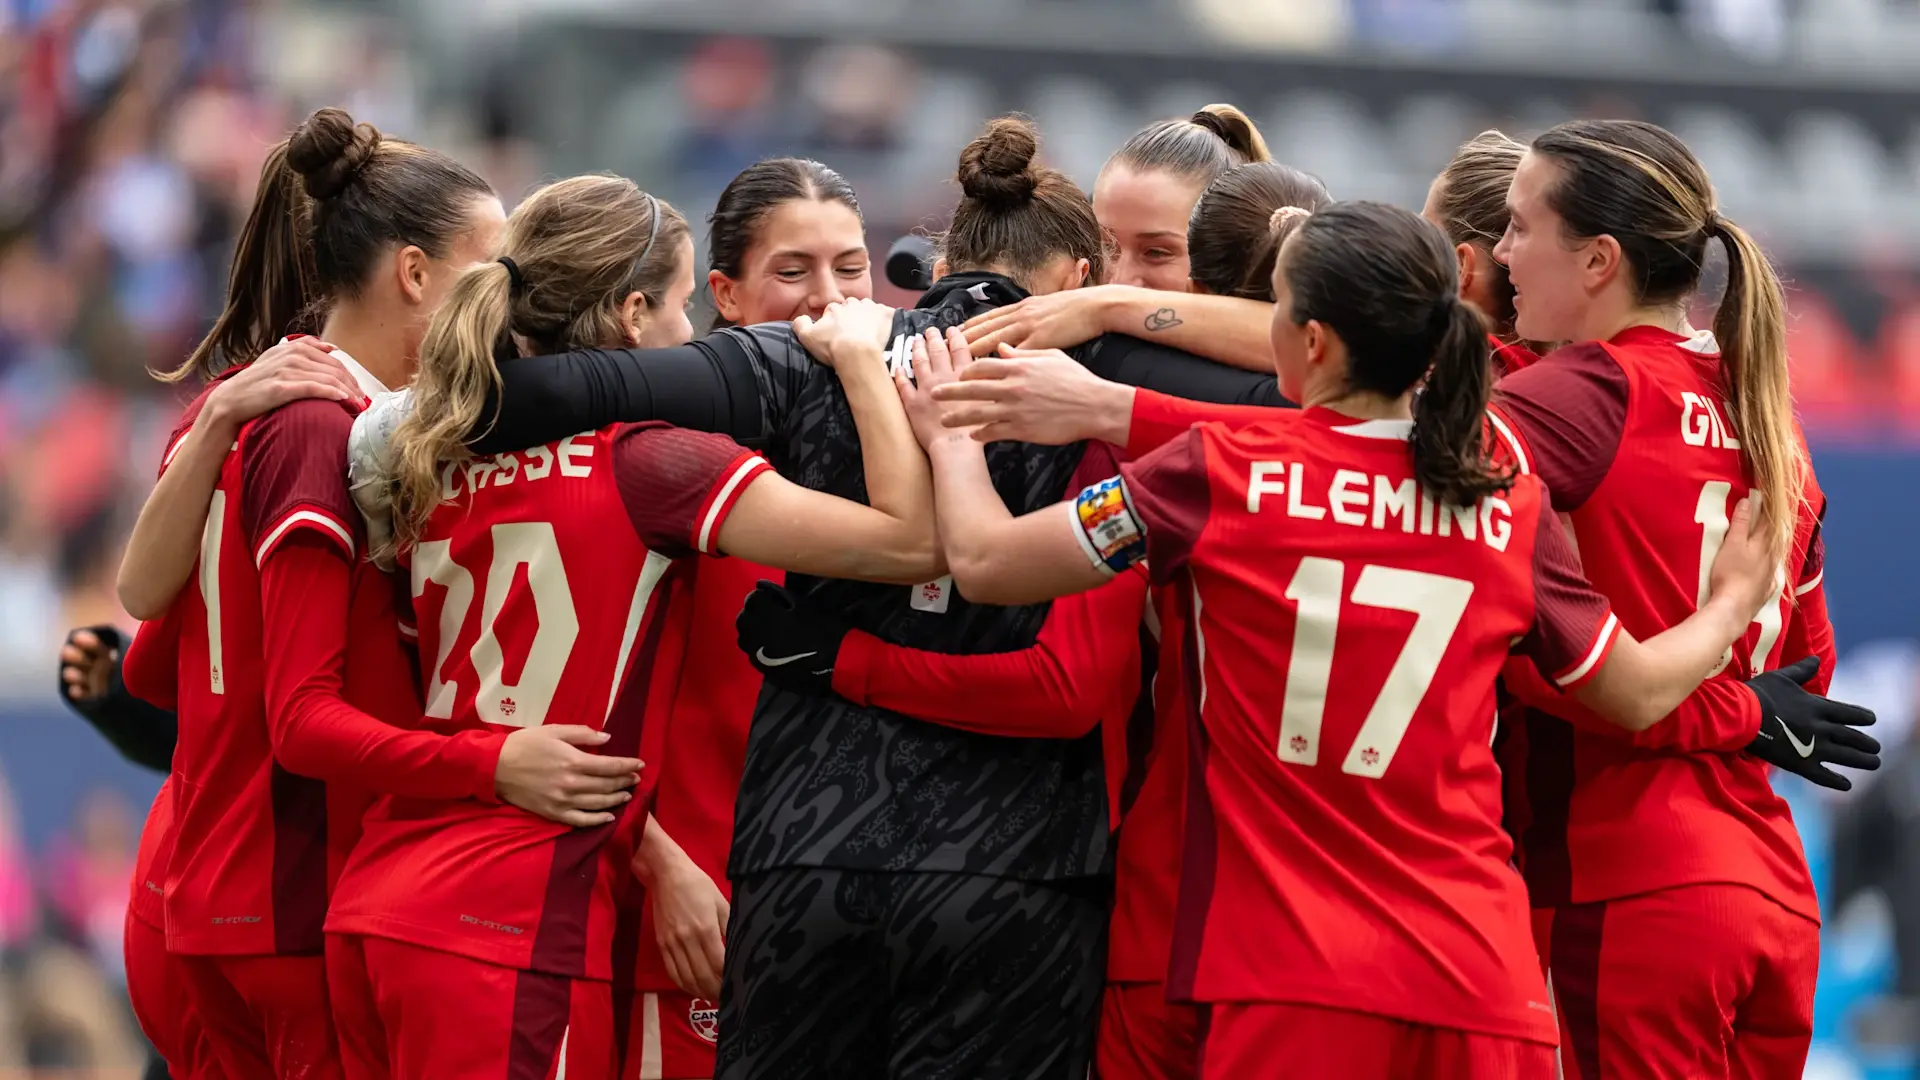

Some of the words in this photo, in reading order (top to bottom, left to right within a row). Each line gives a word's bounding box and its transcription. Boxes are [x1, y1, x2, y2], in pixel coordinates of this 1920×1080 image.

[1247, 460, 1513, 553] FLEMING
[410, 522, 580, 728] 20
[1276, 555, 1475, 780] 17
